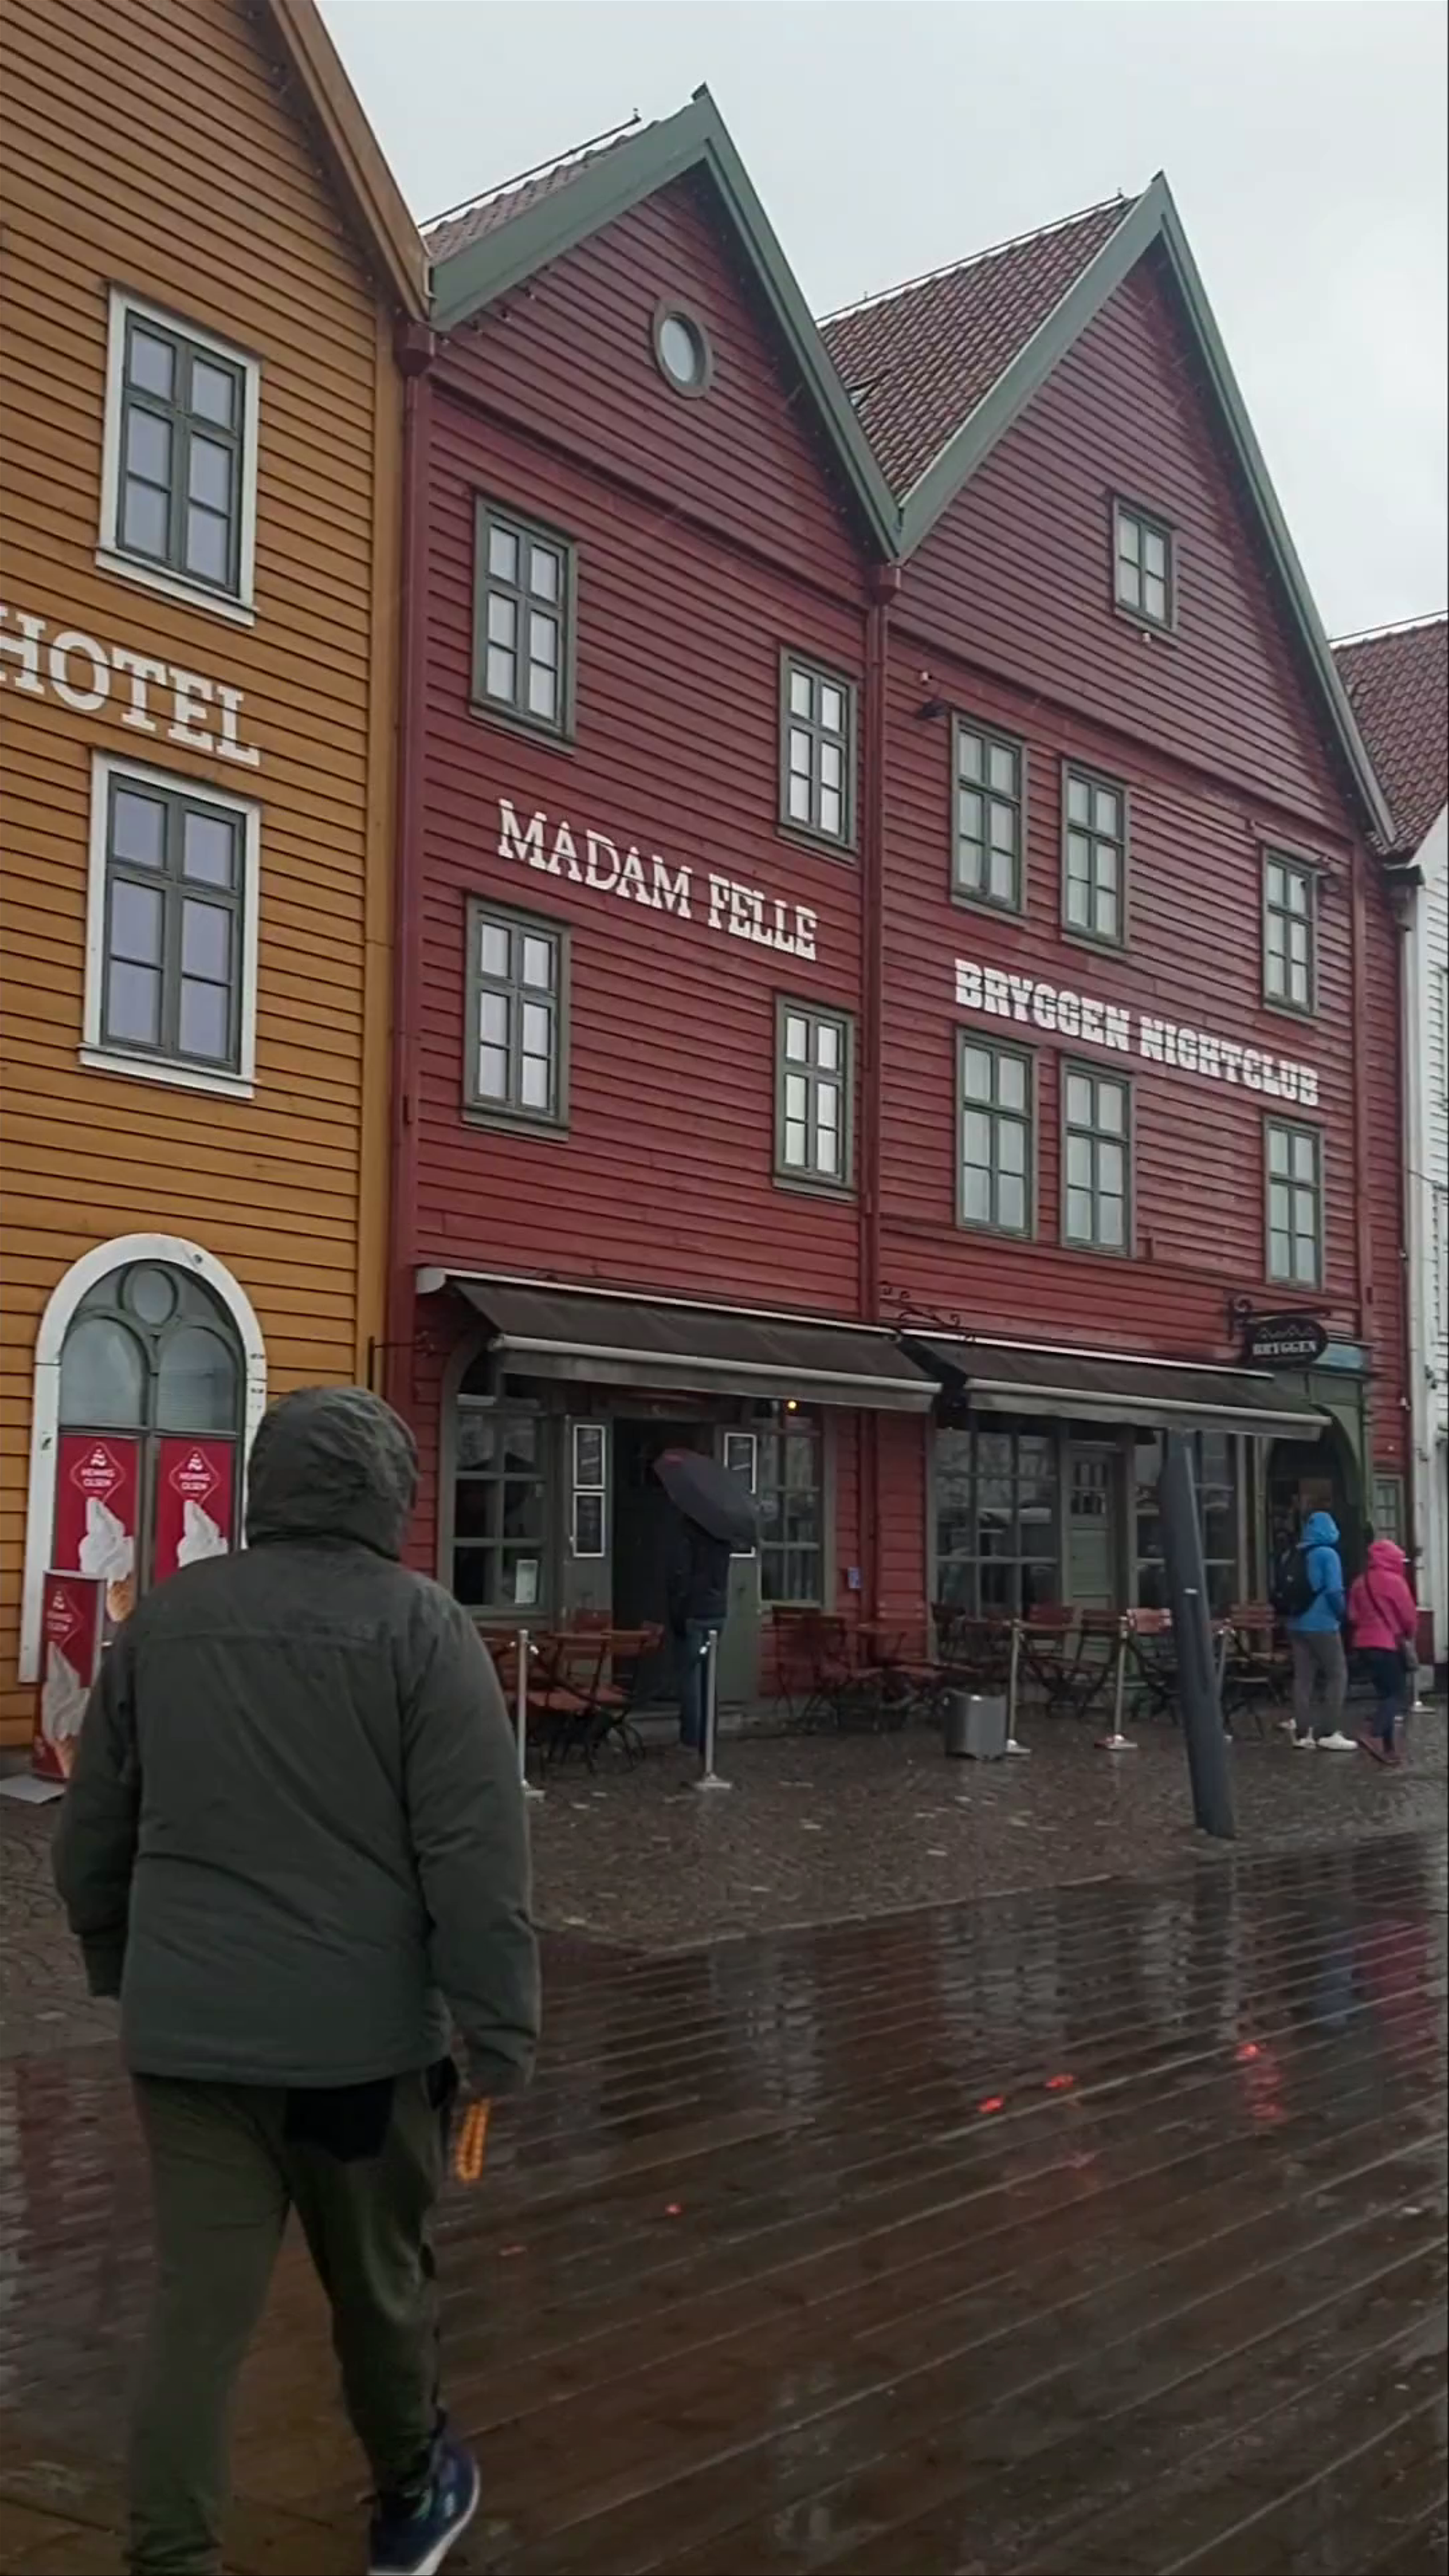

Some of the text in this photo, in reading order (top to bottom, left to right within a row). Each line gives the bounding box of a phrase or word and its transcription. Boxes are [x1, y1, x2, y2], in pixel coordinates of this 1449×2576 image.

[0, 606, 260, 767] HOTEL
[498, 798, 818, 961] MADAM FELLE
[955, 958, 1319, 1106] BRYGGEN NIGHTCLUB
